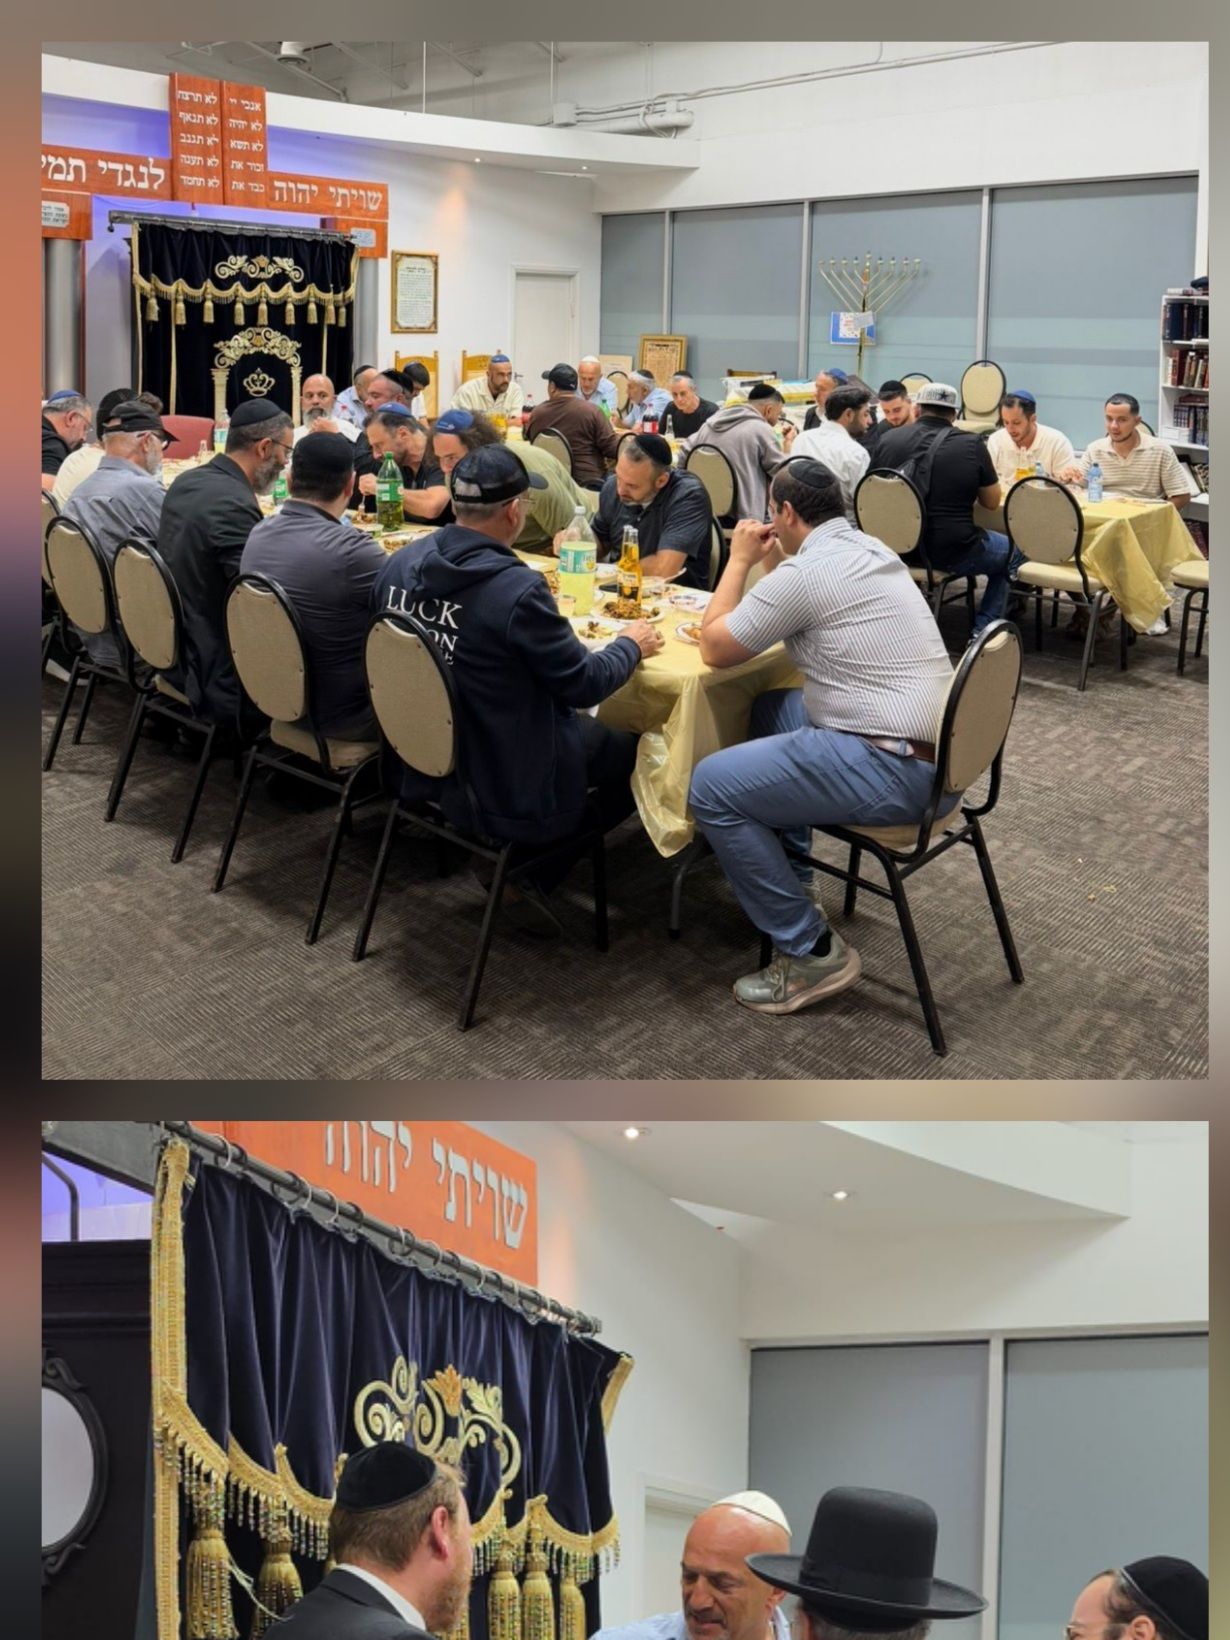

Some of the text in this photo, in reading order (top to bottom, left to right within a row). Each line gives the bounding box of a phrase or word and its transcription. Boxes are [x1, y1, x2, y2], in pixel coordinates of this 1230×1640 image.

[204, 92, 218, 105] לא
[205, 113, 219, 126] לא
[250, 119, 263, 132] לא
[206, 133, 219, 146] לא
[251, 139, 264, 152] לא
[206, 155, 220, 167] לא
[230, 159, 244, 170] את
[97, 156, 165, 190] לנגדי
[207, 175, 220, 188] לא
[231, 181, 245, 191] את
[273, 179, 319, 205] יהוה
[328, 184, 383, 211] שויתי
[386, 585, 463, 630] LUCK
[432, 1137, 528, 1249] שויתי
